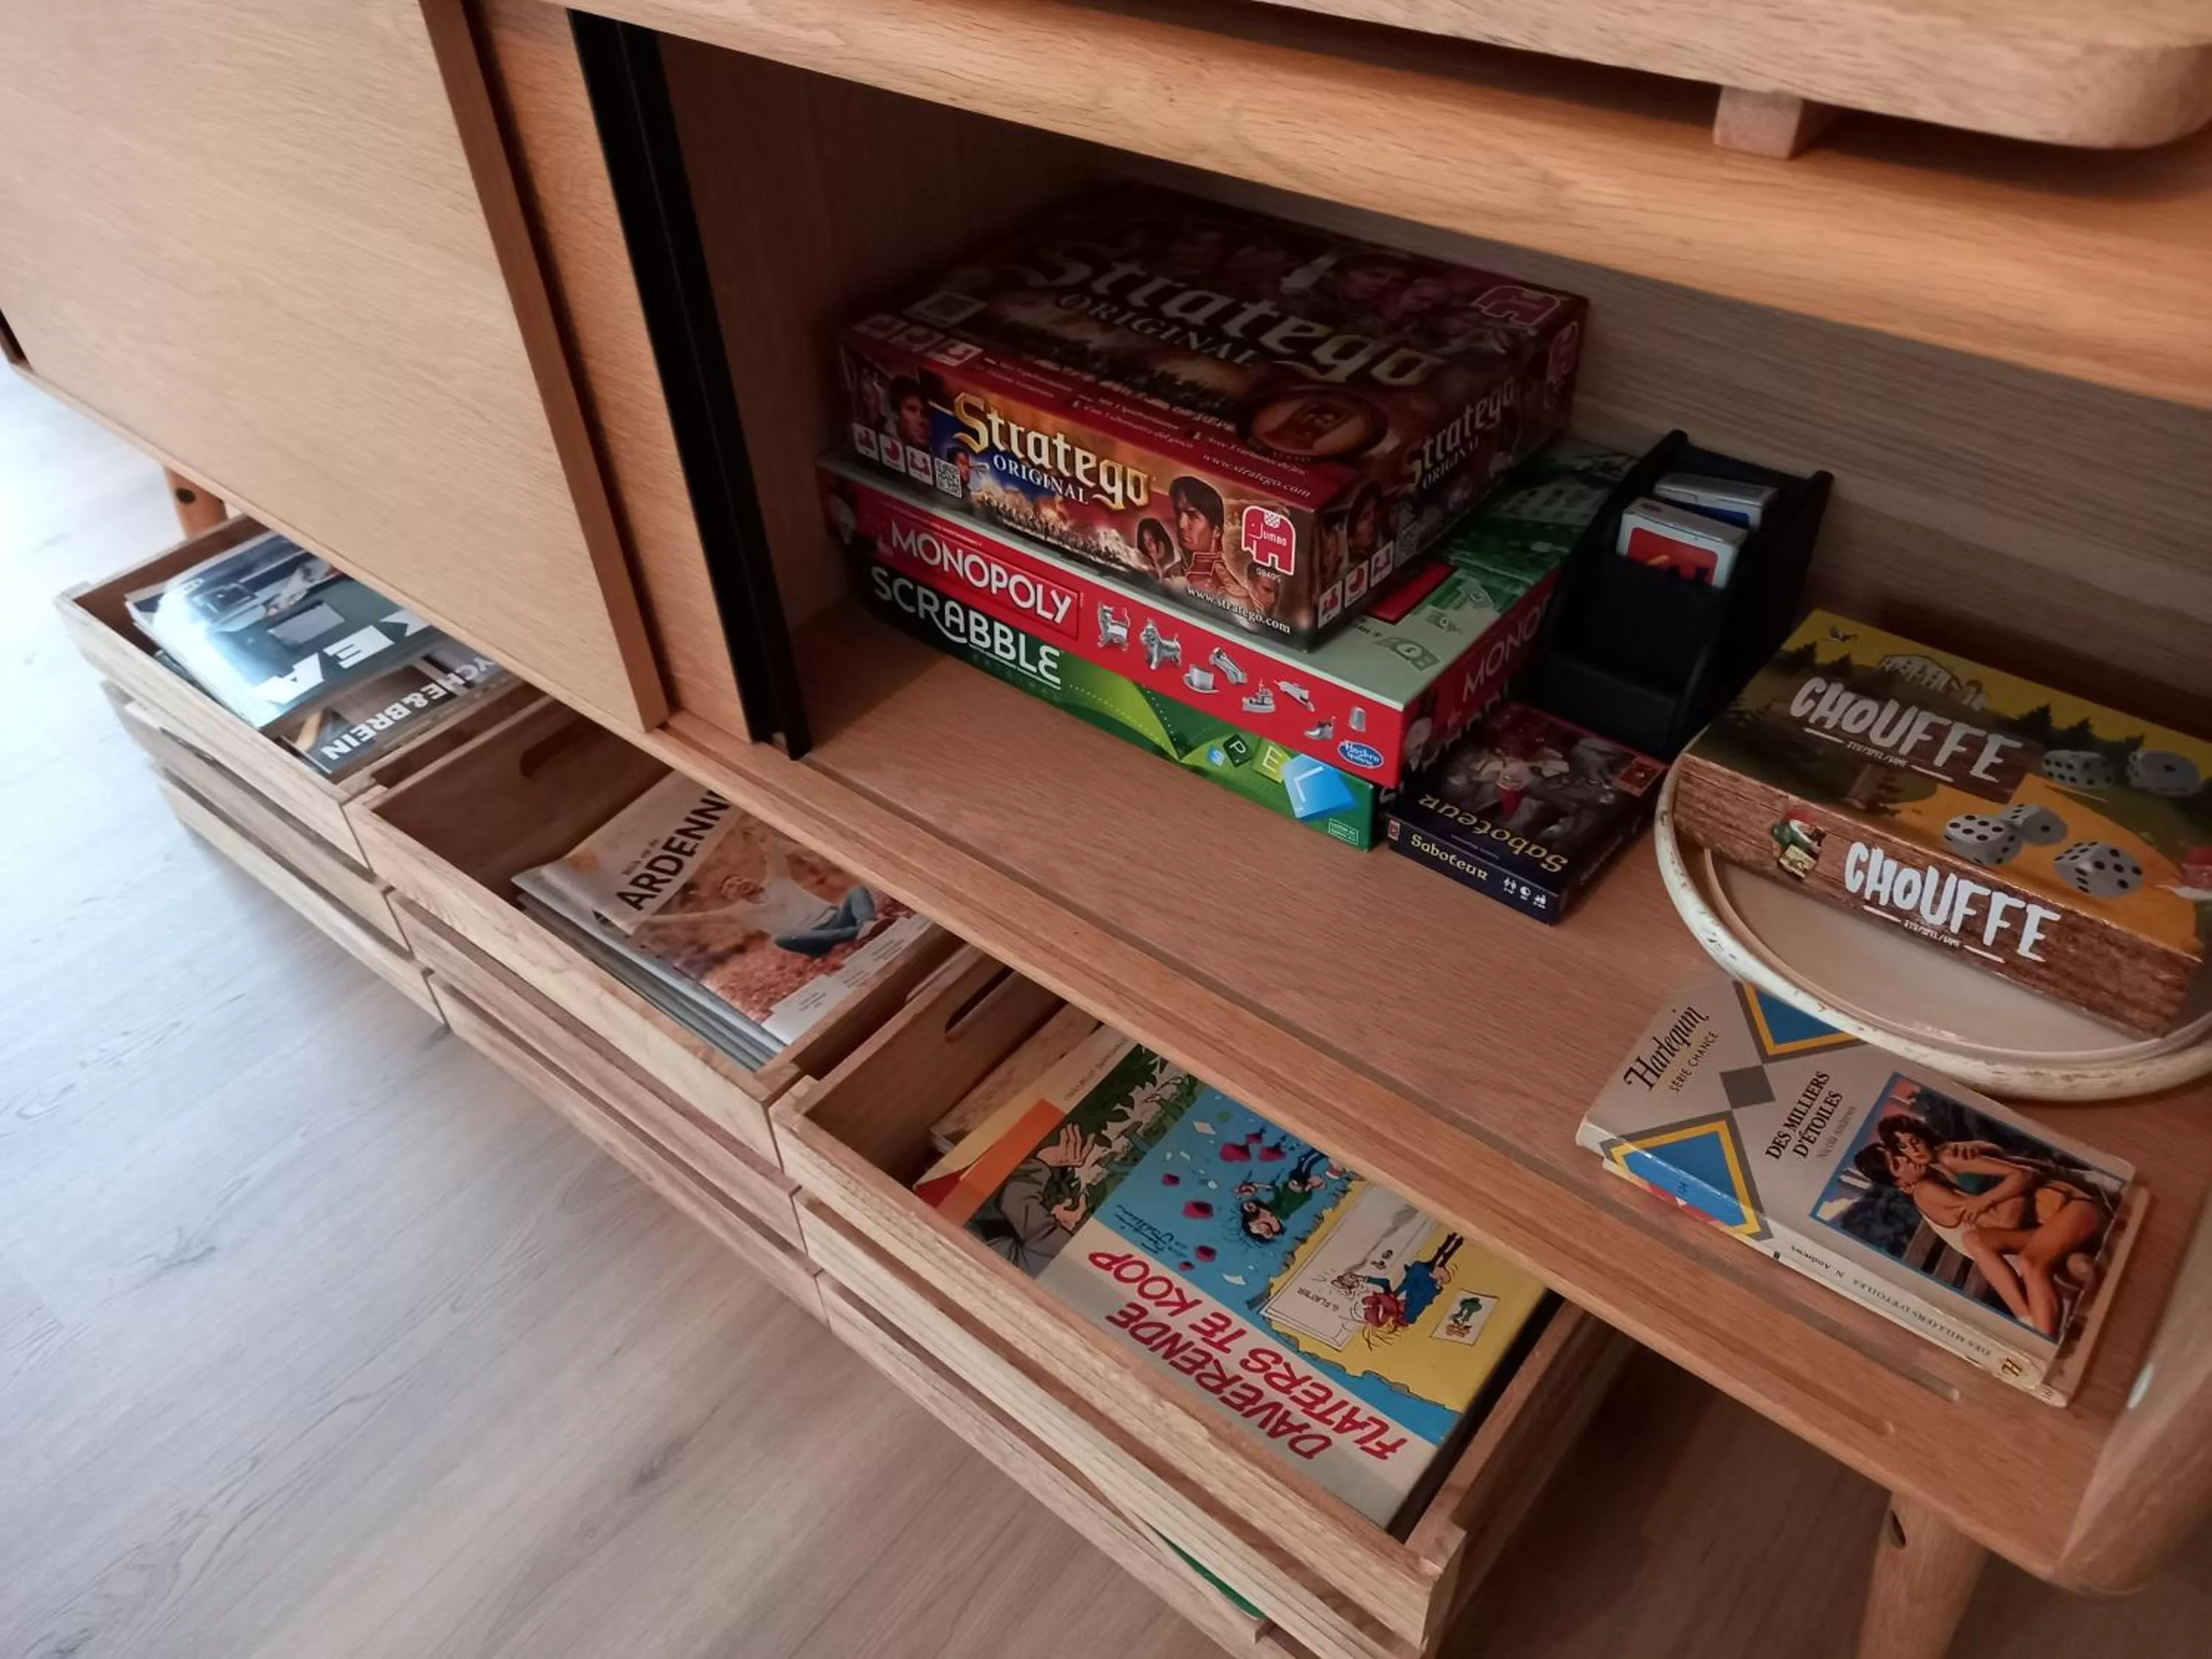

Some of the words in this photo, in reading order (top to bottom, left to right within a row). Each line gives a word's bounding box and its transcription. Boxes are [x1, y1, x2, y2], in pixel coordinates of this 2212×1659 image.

[1015, 240, 1444, 386] Stratego
[1055, 293, 1258, 366] ORIGINAL
[953, 392, 1150, 509] Stratego
[993, 453, 1090, 506] ORIGINAL
[891, 519, 1071, 626] MONOPOLY
[1186, 588, 1291, 634] www.stratego.com
[871, 566, 1062, 690] SCRABBLE
[1790, 676, 2022, 783] CHOUFFE
[1411, 833, 1489, 881] Saboteur
[1419, 793, 1568, 874] Saboteur
[1845, 842, 2061, 962] CHOUFFE
[1623, 1006, 1710, 1092] Harlequin
[1688, 1031, 1719, 1067] CHANCE
[1765, 1130, 1792, 1159] DES
[1783, 1071, 1830, 1132] MILLIERS
[1792, 1091, 1843, 1158] D'ÉTOILES
[1088, 1252, 1202, 1317] KOOP
[1189, 1312, 1246, 1354] TE
[1106, 1302, 1332, 1460] DAVERENDE
[1239, 1348, 1407, 1460] FLATERS
